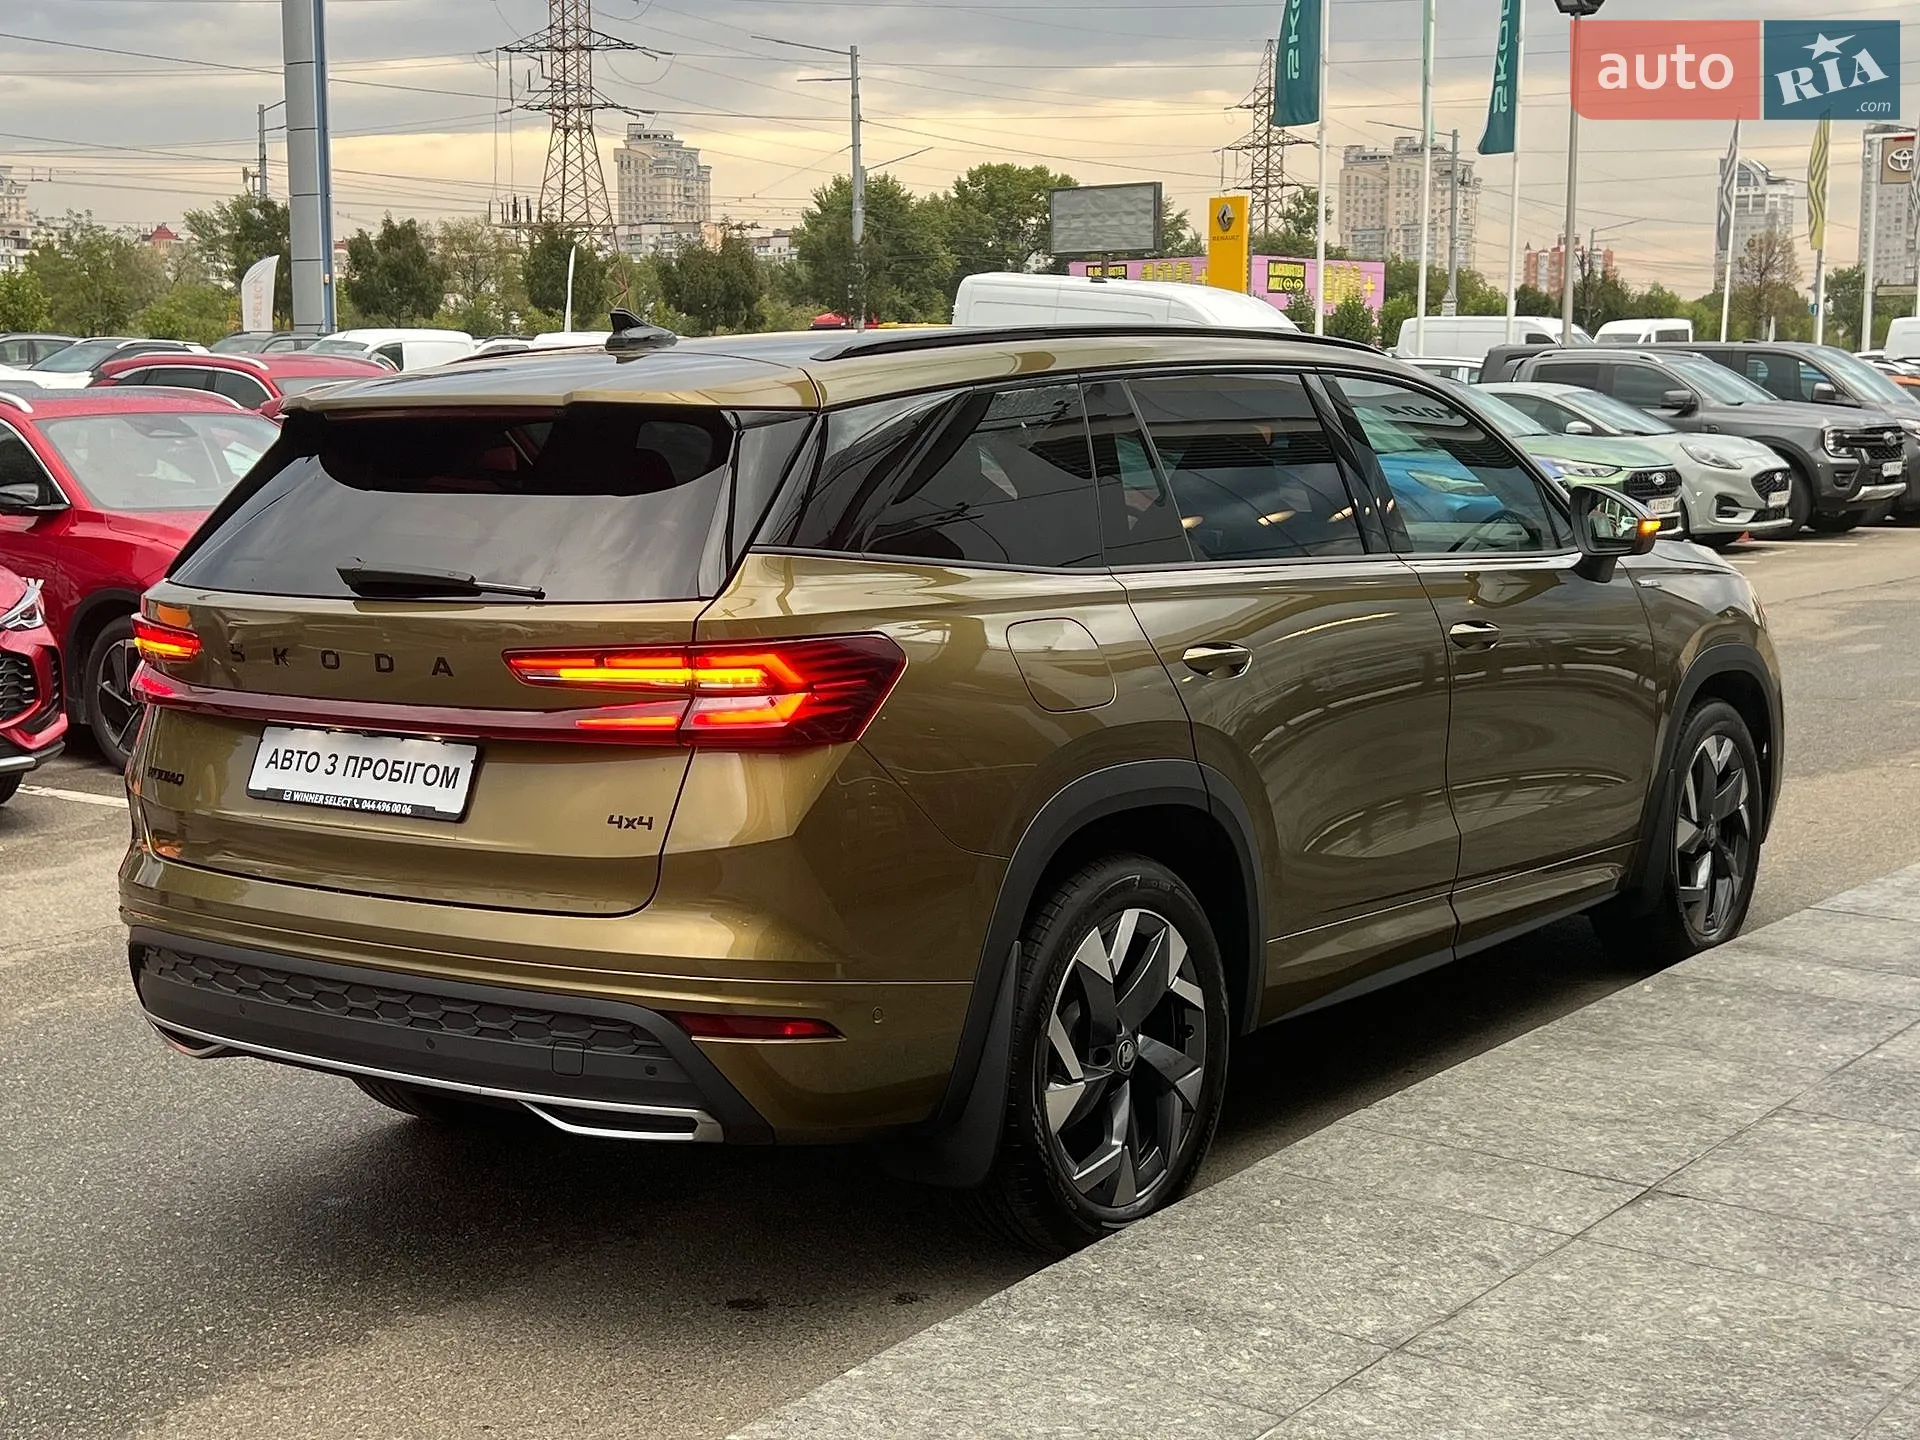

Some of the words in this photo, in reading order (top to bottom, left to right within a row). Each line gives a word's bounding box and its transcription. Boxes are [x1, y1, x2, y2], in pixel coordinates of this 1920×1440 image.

[265, 748, 321, 773] АВТО
[343, 755, 461, 790] ПРОБІГОМ
[293, 791, 323, 804] WINNER
[324, 795, 352, 808] SELECT
[377, 801, 391, 812] 496
[391, 803, 401, 813] 00
[401, 804, 412, 814] 06
[607, 814, 653, 831] 4x4
